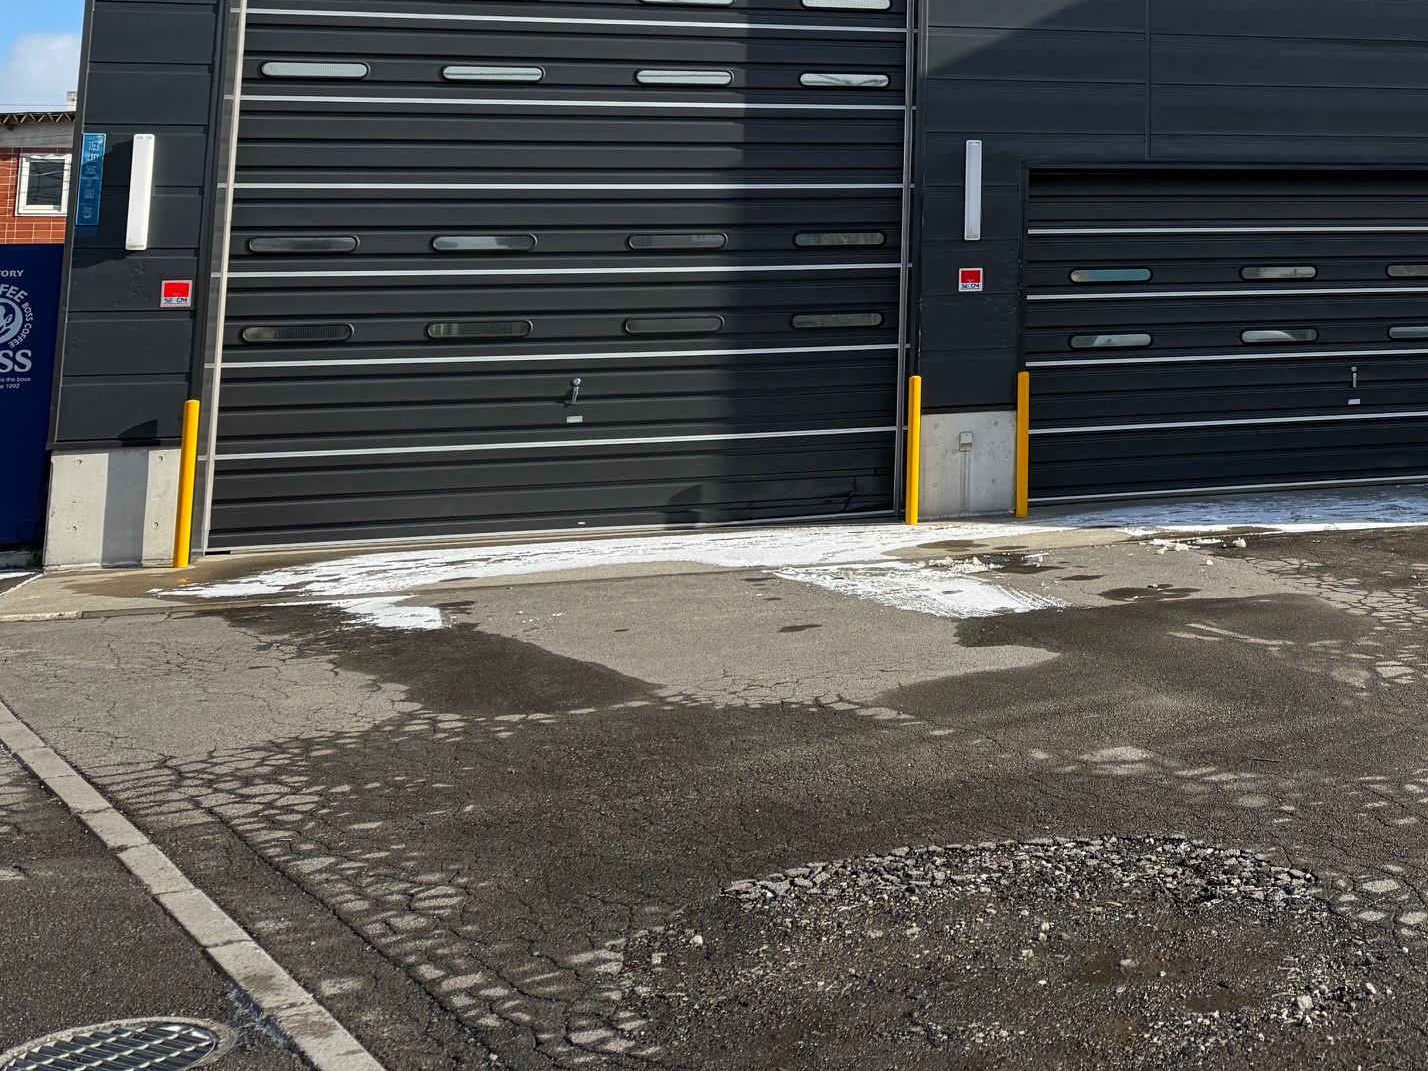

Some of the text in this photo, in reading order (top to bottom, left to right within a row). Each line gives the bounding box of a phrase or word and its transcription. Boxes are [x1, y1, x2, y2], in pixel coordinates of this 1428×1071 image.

[0, 269, 24, 278] ORY
[8, 302, 34, 348] BOSS COFFEE
